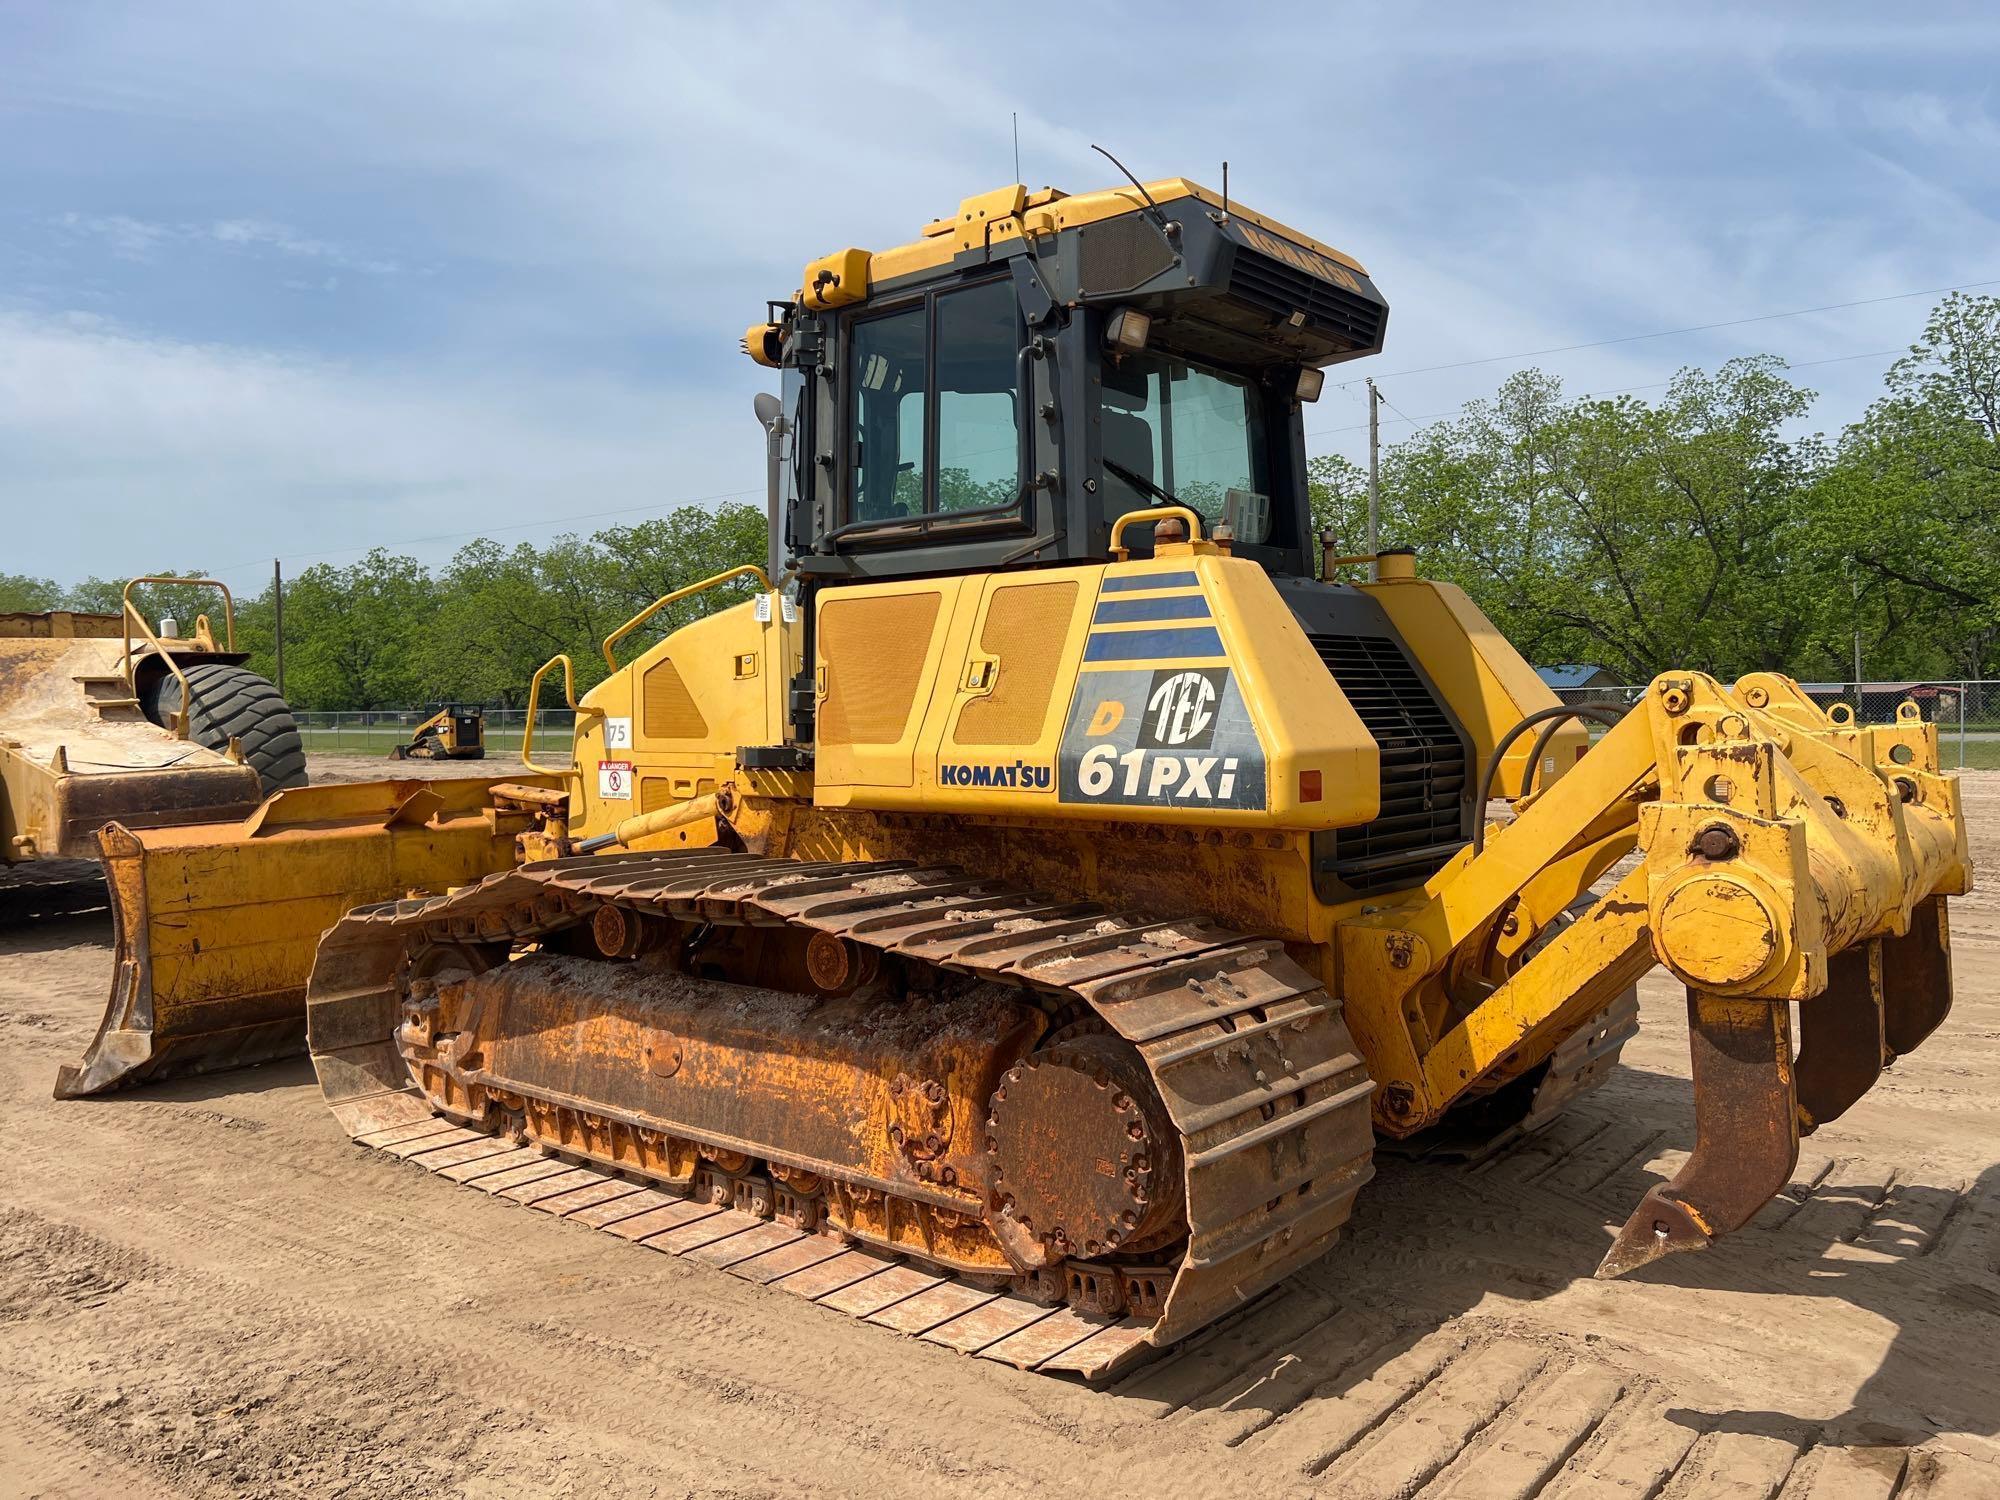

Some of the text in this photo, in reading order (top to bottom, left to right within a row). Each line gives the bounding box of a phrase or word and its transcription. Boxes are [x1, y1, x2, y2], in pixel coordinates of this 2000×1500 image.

[1236, 222, 1362, 293] KOMATSU
[1085, 701, 1125, 736] D
[607, 762, 629, 772] DANGER
[941, 760, 1050, 788] KOMATSU
